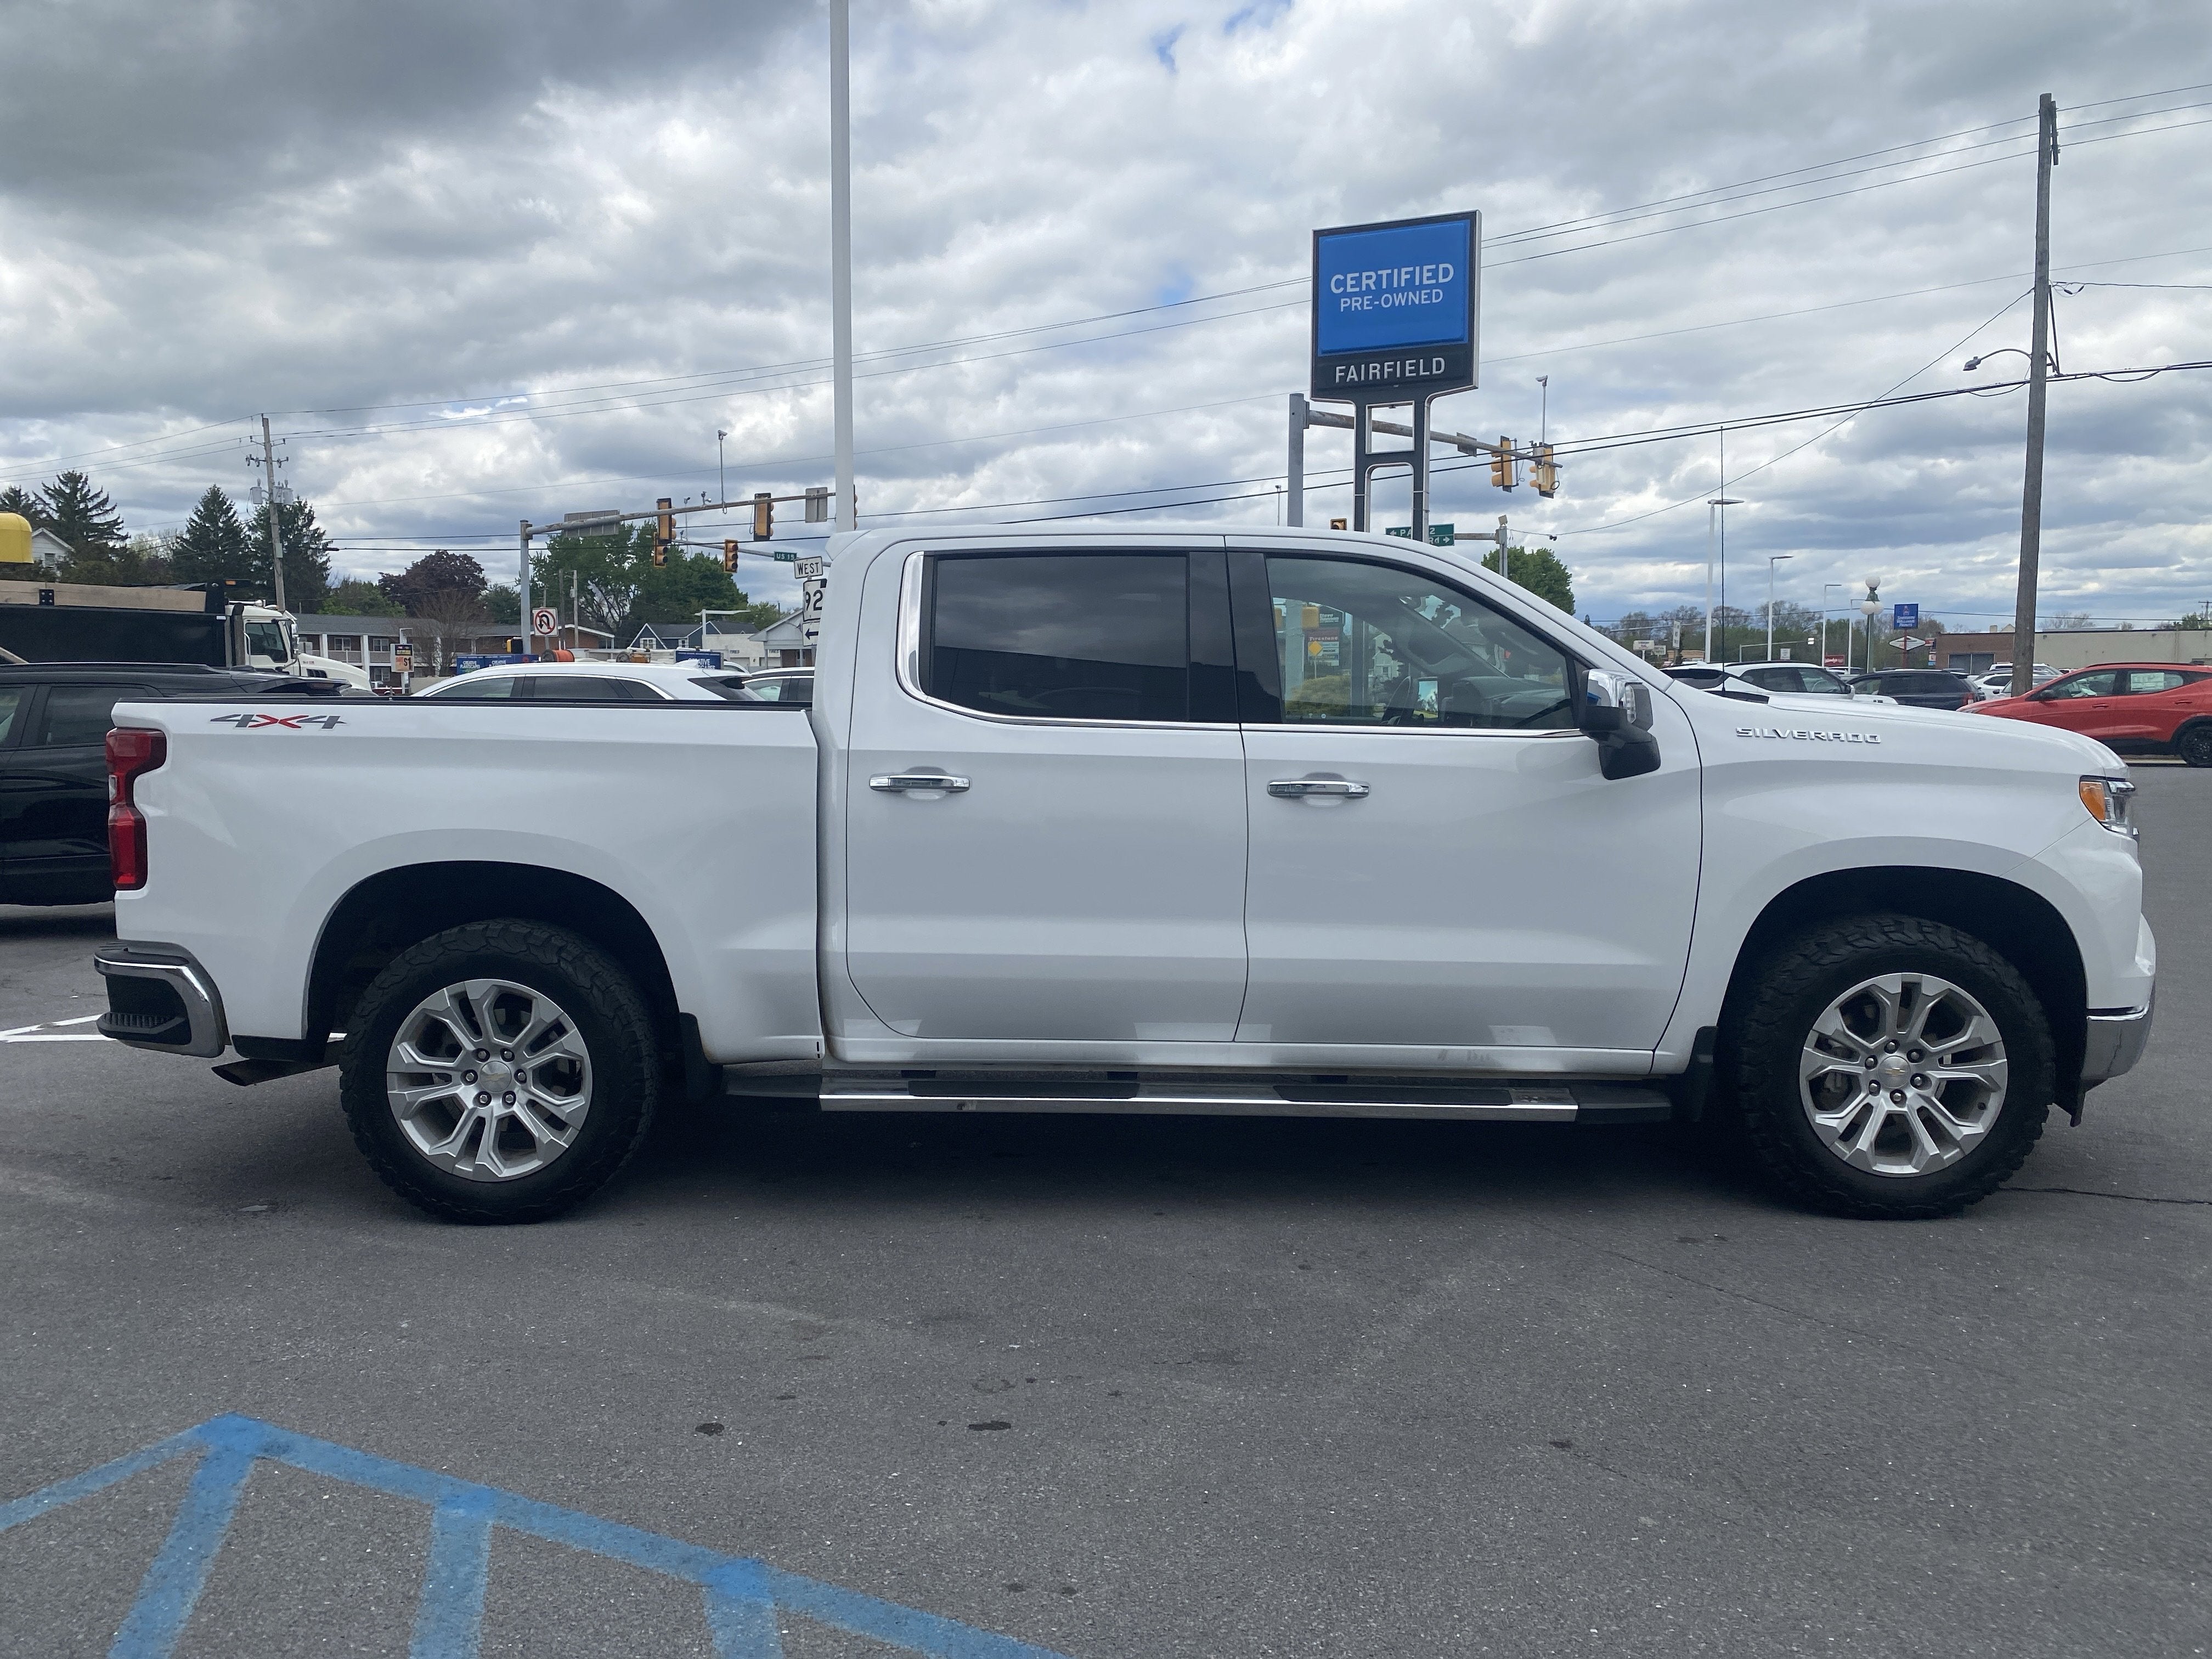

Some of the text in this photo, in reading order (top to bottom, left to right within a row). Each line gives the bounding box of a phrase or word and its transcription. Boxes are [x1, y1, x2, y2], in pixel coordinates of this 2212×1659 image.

[1330, 263, 1454, 294] CERTIFIED
[1340, 289, 1443, 312] PRE-OWNED
[1335, 357, 1446, 383] FAIRFIELD
[797, 562, 820, 575] WEST
[1736, 727, 1882, 743] SILVERADO
